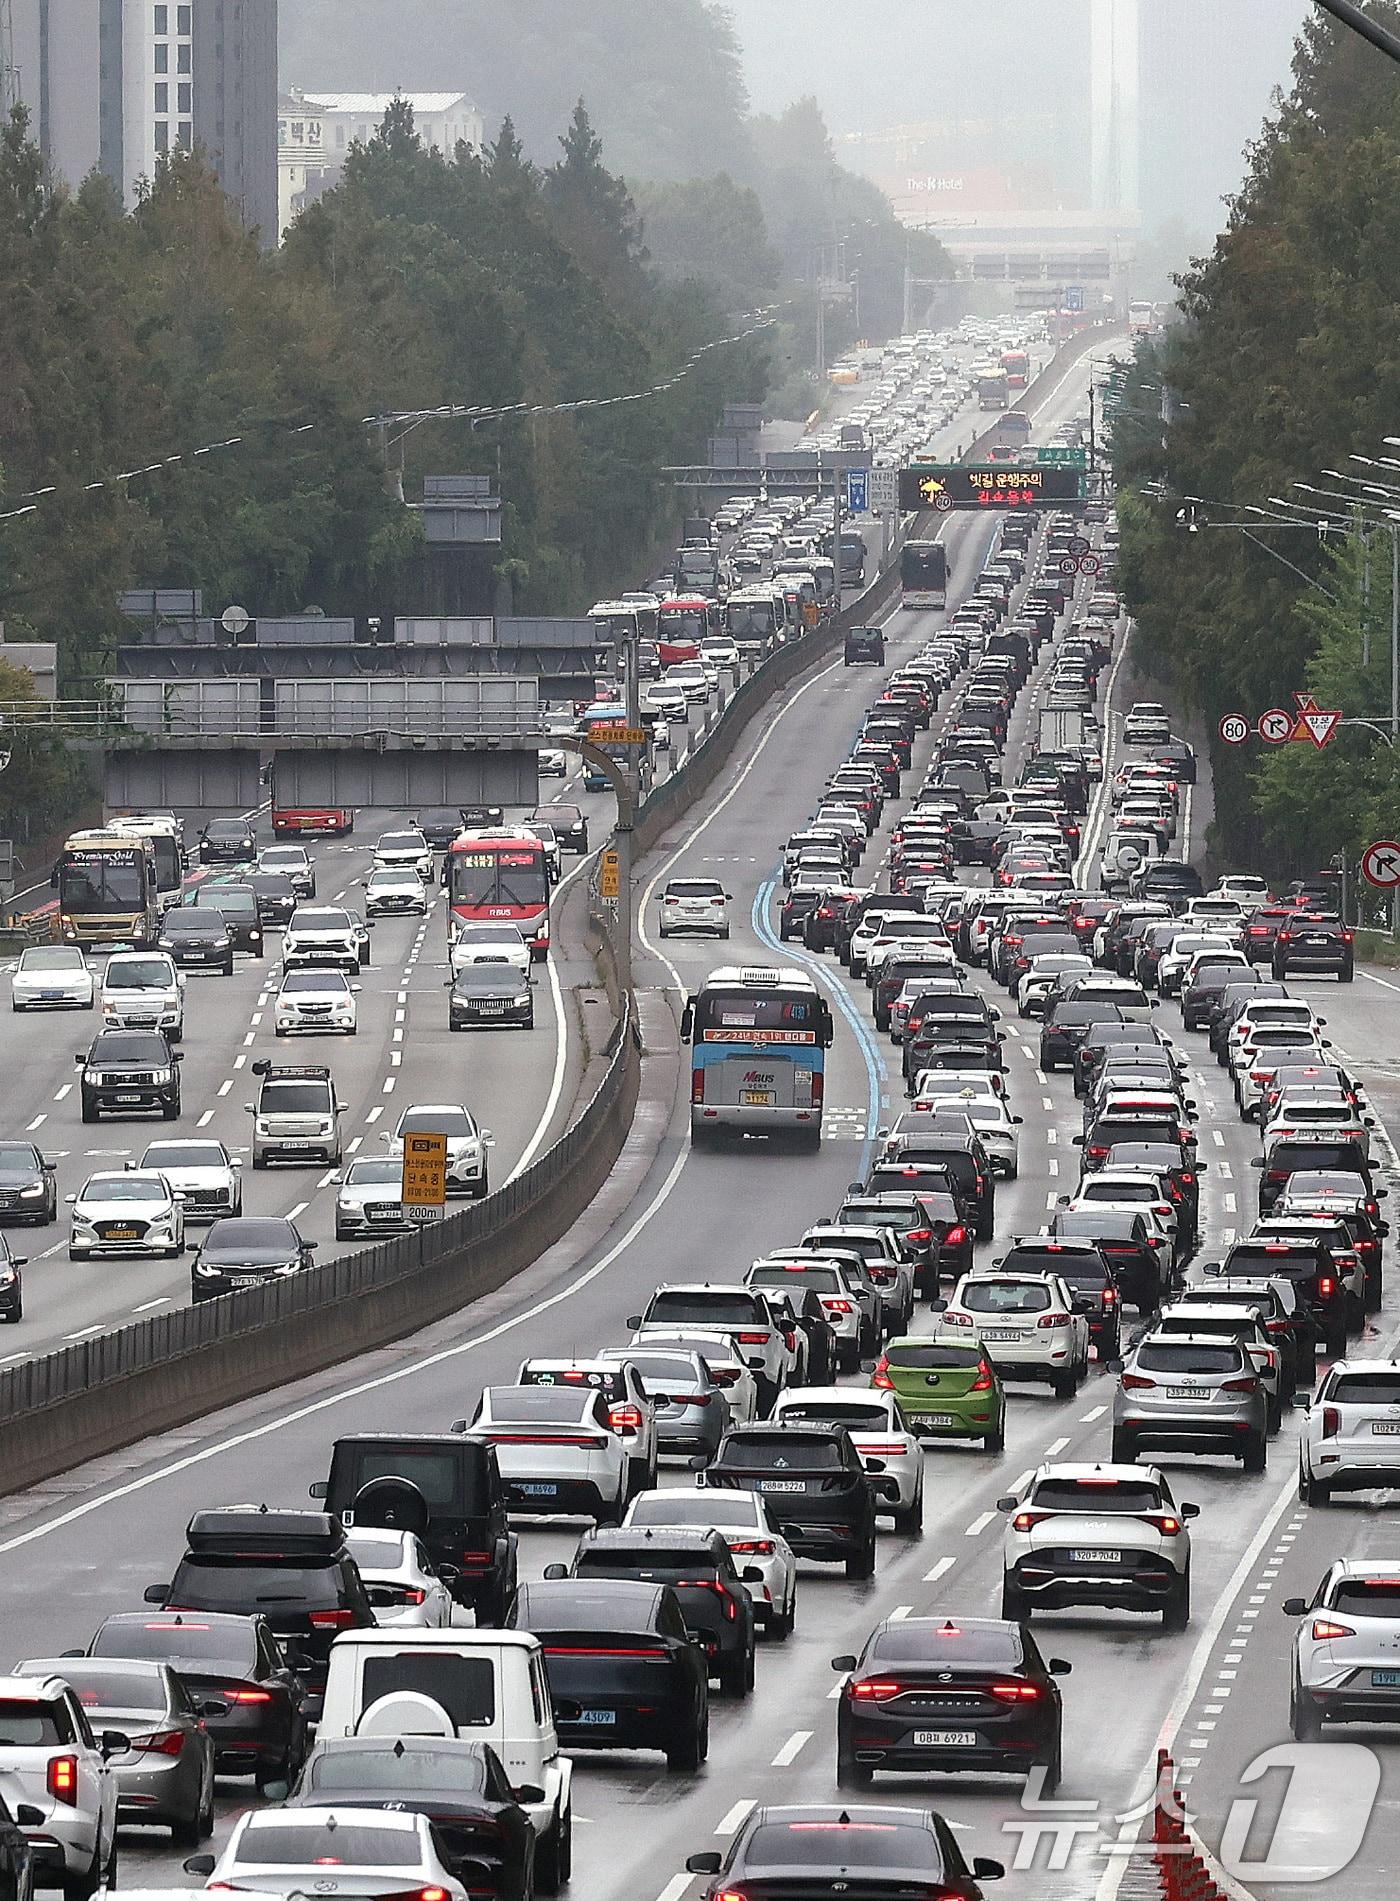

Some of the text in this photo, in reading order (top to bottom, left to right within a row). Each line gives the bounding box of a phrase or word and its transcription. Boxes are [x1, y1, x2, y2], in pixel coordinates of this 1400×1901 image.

[969, 471, 1043, 488] 빗길 운행주의
[1225, 722, 1244, 738] 80
[743, 1071, 775, 1084] MBUS
[409, 1207, 437, 1218] 200m
